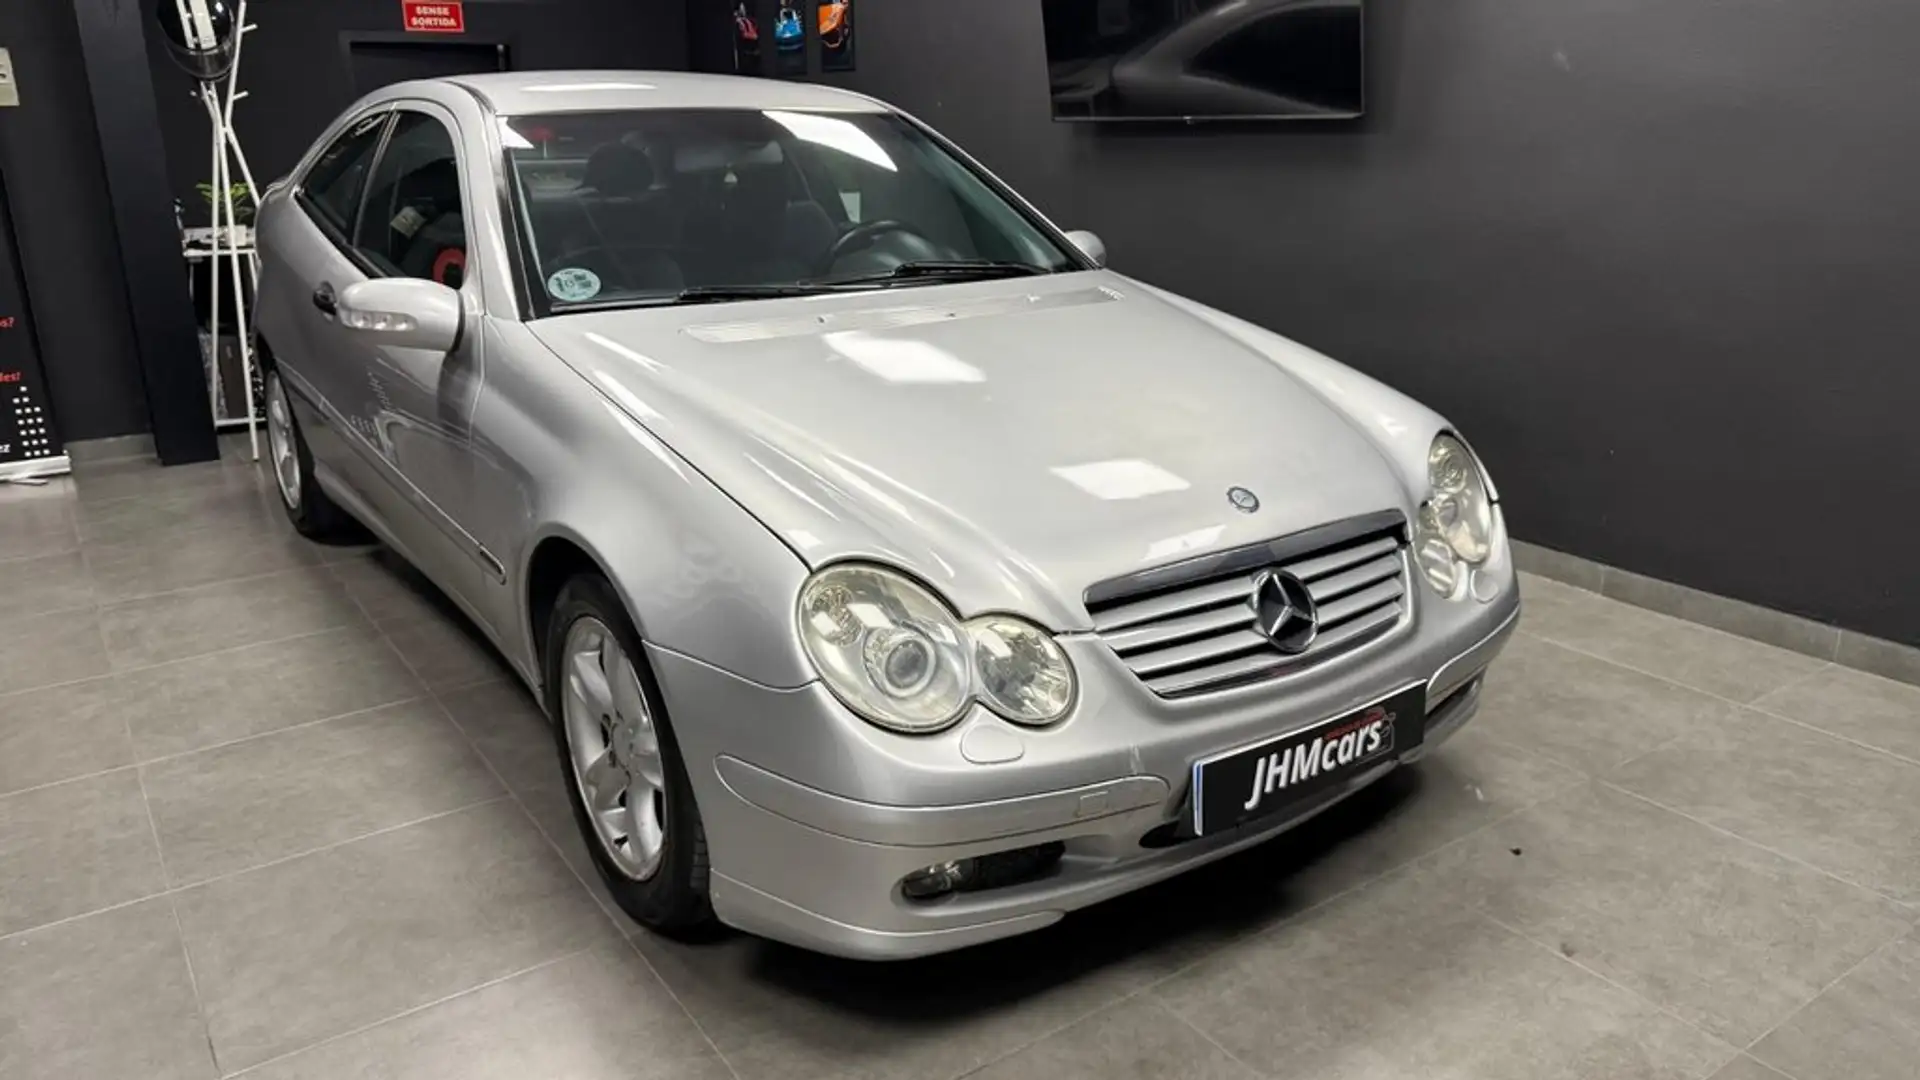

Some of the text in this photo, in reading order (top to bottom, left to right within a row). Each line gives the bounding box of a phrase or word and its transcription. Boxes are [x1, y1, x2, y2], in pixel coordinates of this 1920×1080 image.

[415, 6, 450, 16] SENSE
[411, 16, 457, 27] SORTIDA
[1244, 719, 1382, 810] JHMcars
